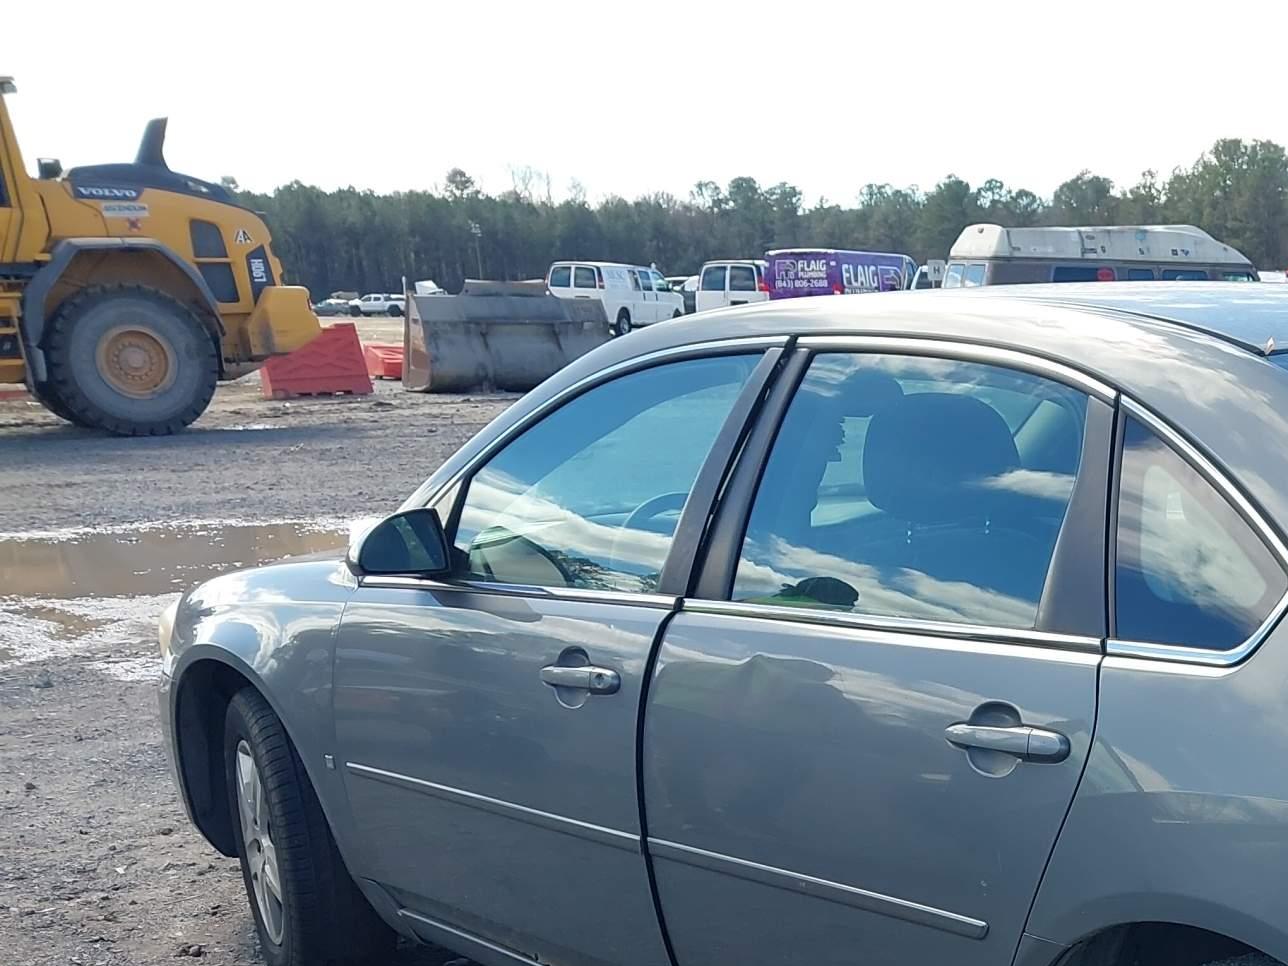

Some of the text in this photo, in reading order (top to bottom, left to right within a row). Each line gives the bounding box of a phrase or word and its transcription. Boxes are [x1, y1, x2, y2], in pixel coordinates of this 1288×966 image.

[77, 186, 137, 197] VOLVO
[250, 259, 267, 282] L90H
[798, 260, 826, 271] FLAIG
[841, 264, 879, 288] FLAIG
